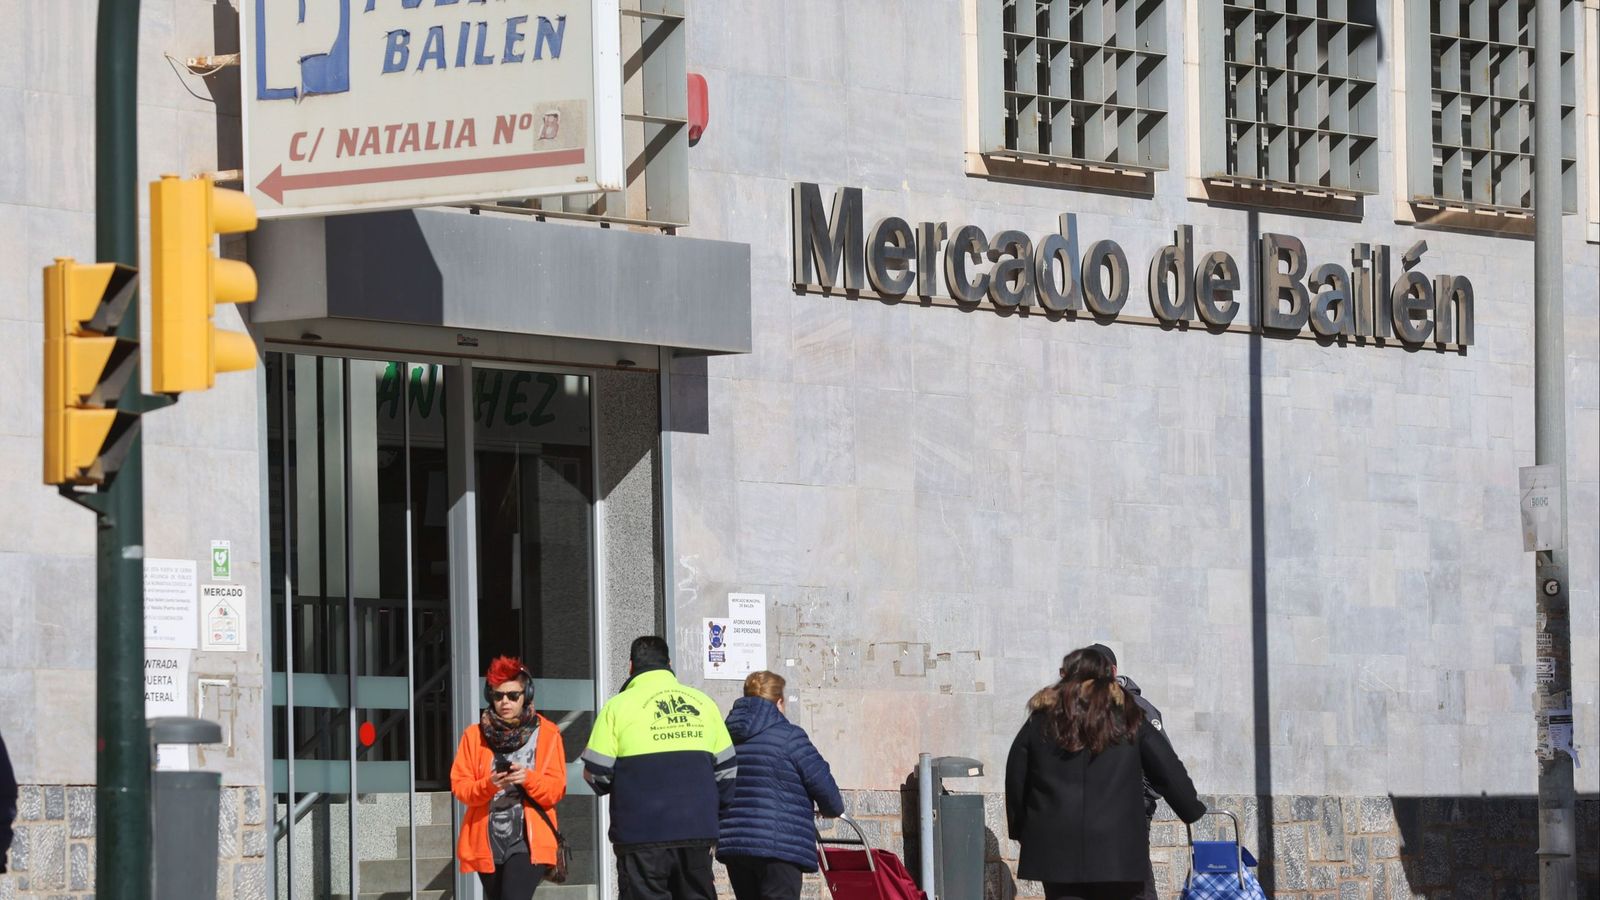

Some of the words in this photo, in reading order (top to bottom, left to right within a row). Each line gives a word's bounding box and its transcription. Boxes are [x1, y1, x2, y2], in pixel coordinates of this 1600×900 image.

[380, 14, 567, 75] BAILEN
[288, 126, 325, 163] C/
[335, 117, 478, 159] NATALIA
[791, 181, 1130, 317] Mercado
[1149, 223, 1240, 326] de
[1260, 232, 1475, 347] Bailén
[203, 587, 243, 597] MERCADO
[144, 659, 178, 669] NTRADA
[144, 675, 173, 685] UERTA
[144, 692, 174, 702] ATERAL
[667, 716, 688, 724] MB
[653, 730, 704, 741] CONSERJE
